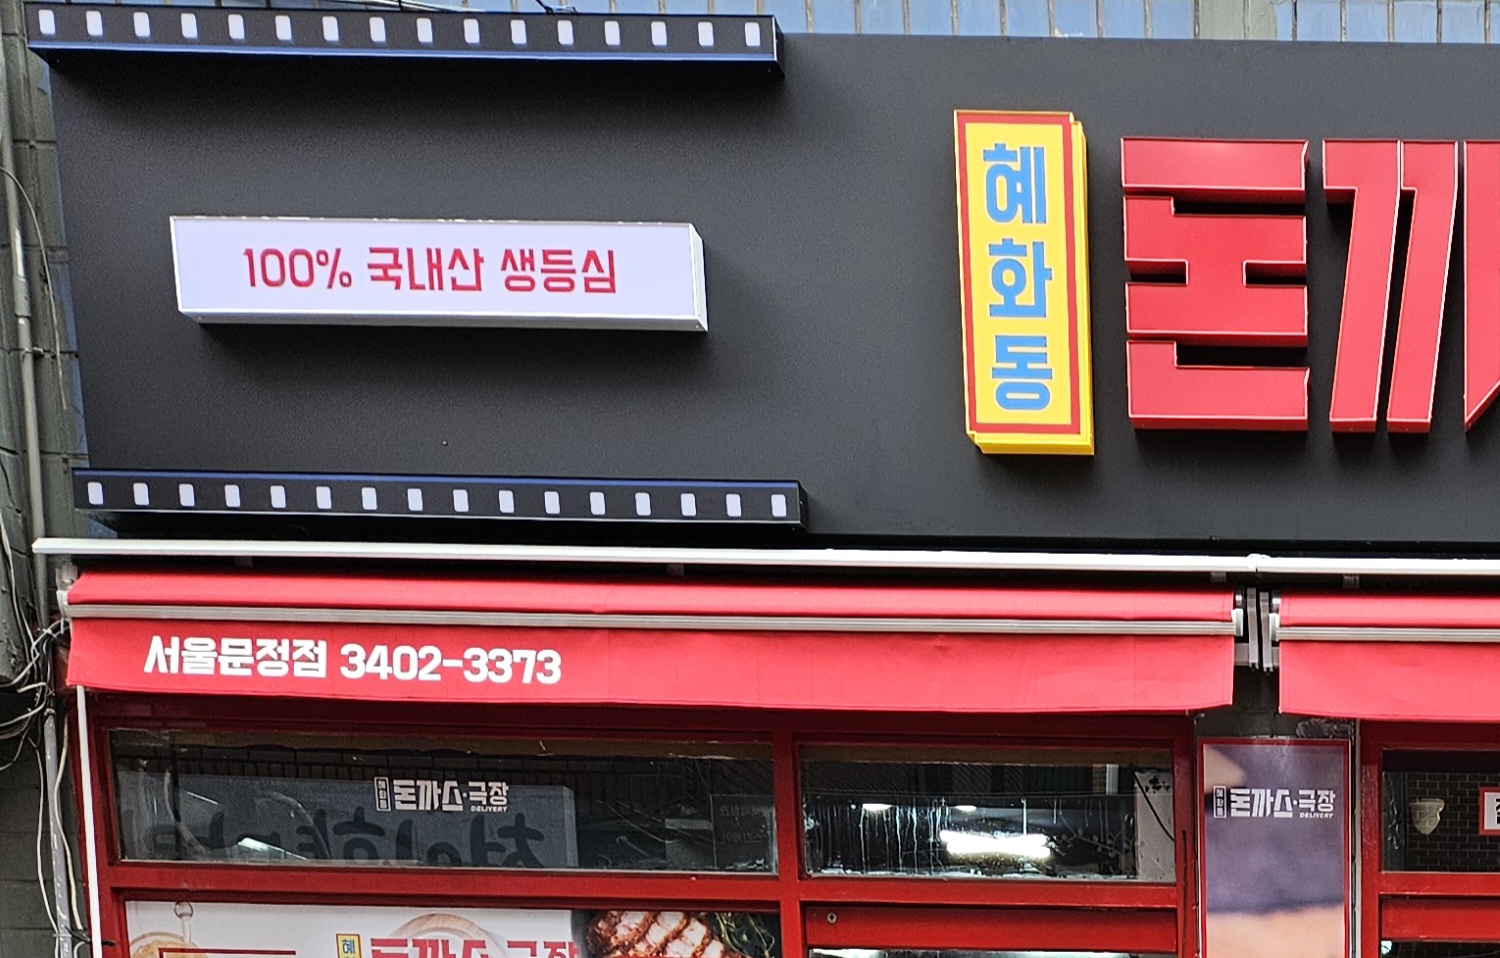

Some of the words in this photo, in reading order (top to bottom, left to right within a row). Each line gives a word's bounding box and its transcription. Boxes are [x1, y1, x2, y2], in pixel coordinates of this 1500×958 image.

[242, 246, 353, 289] 100%
[367, 245, 485, 292] 국내산
[500, 247, 618, 295] 생등심
[982, 142, 1053, 411] 혜화동
[143, 635, 328, 678] 서울문정점
[340, 644, 562, 685] 3402-3373
[393, 779, 464, 811] 돈까스
[468, 781, 510, 806] 극장
[1230, 788, 1293, 818] 돈까스
[1298, 789, 1336, 812] 극장
